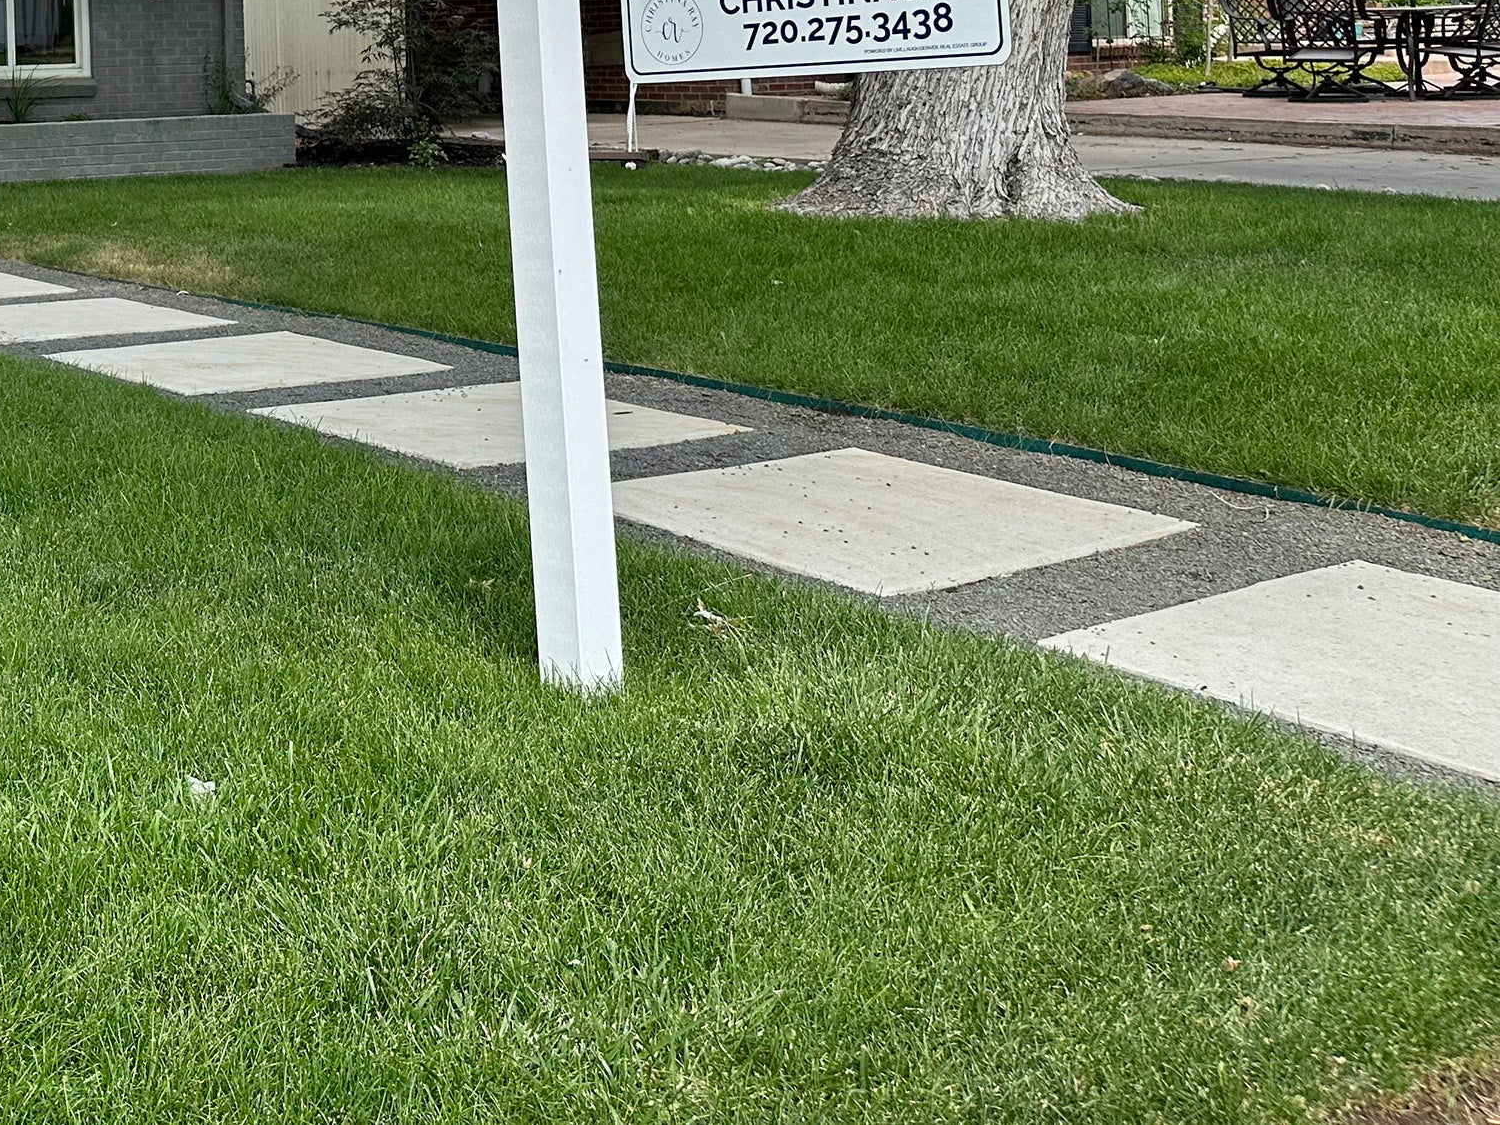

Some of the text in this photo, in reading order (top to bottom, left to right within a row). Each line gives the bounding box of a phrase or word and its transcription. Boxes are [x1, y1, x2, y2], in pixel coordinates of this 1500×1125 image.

[687, 7, 700, 29] RAY
[743, 2, 953, 50] 720.275.3438
[657, 48, 690, 62] HOMES
